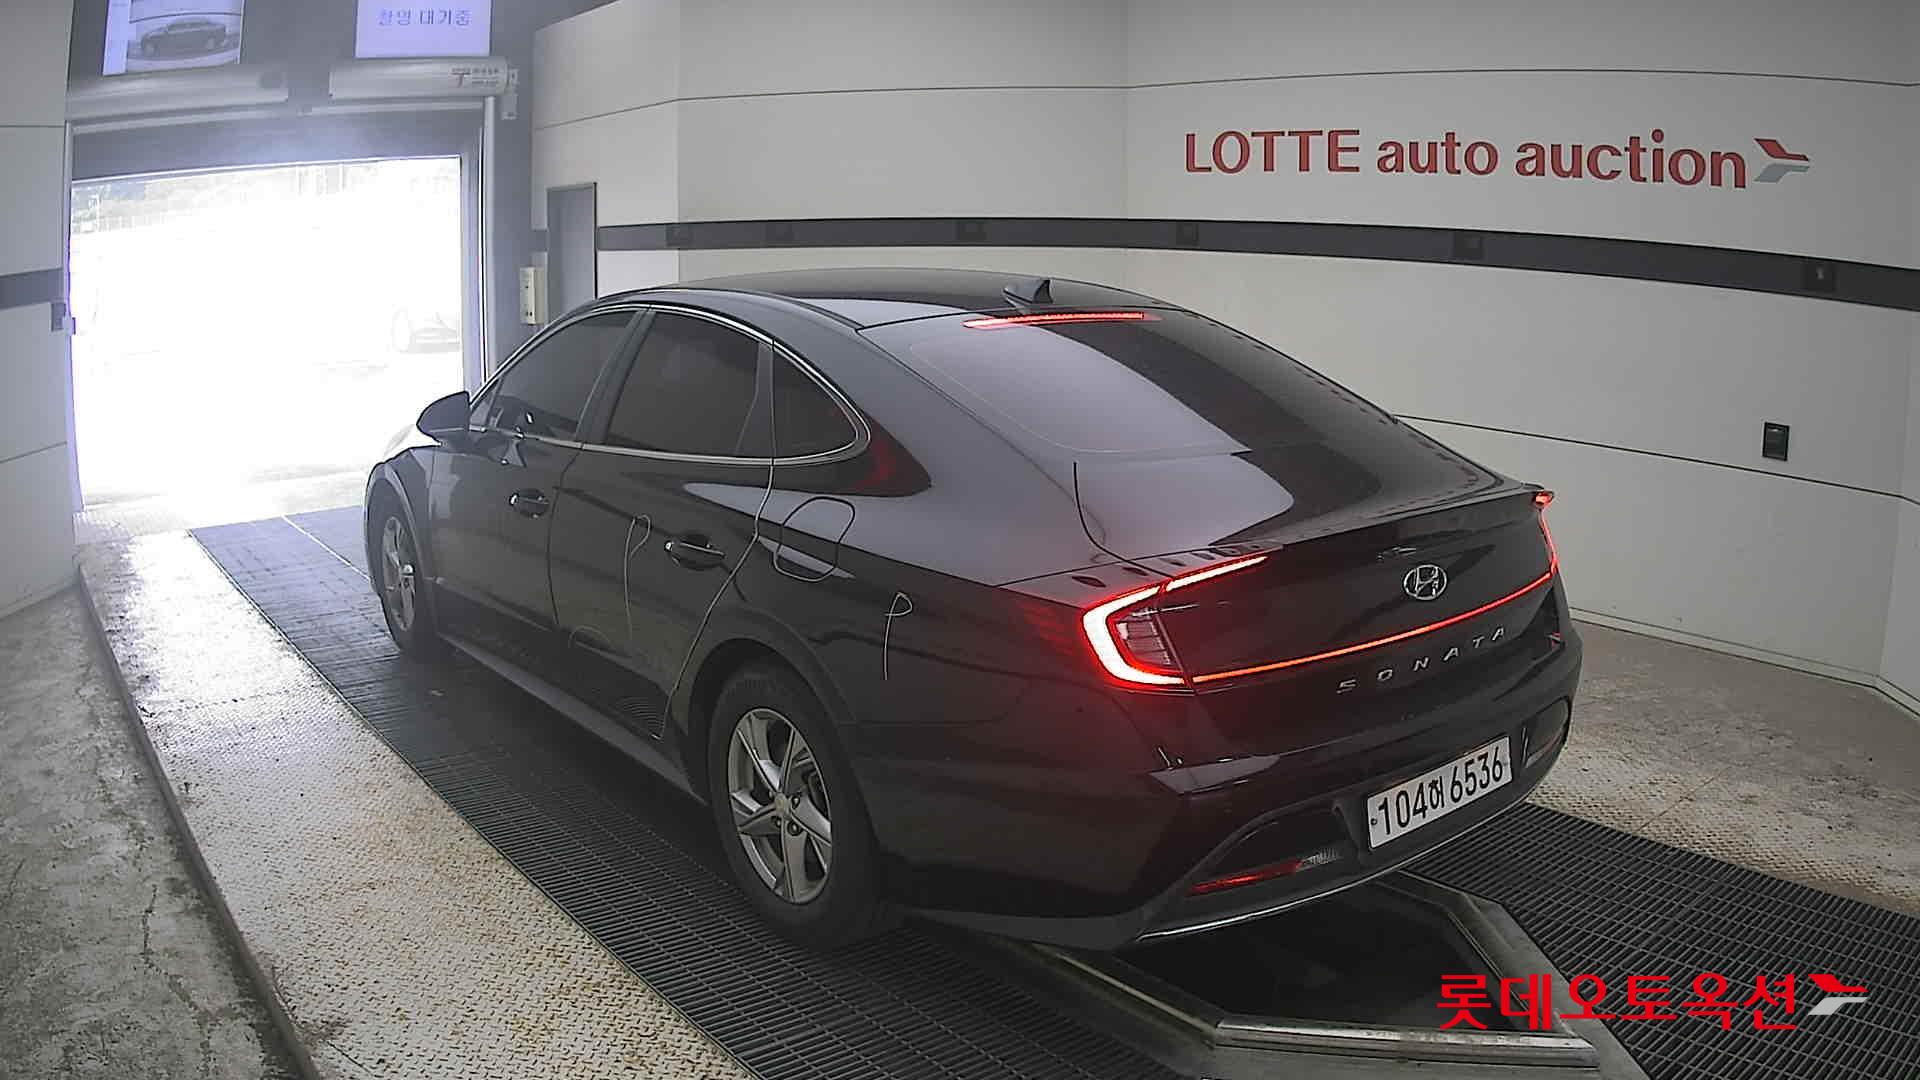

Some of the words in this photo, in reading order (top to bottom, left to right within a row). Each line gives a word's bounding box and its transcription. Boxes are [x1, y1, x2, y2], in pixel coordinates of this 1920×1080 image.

[1185, 129, 1361, 173] LOTTE
[1377, 132, 1499, 176] auto
[1515, 128, 1747, 188] auction
[1336, 626, 1505, 693] SONATA
